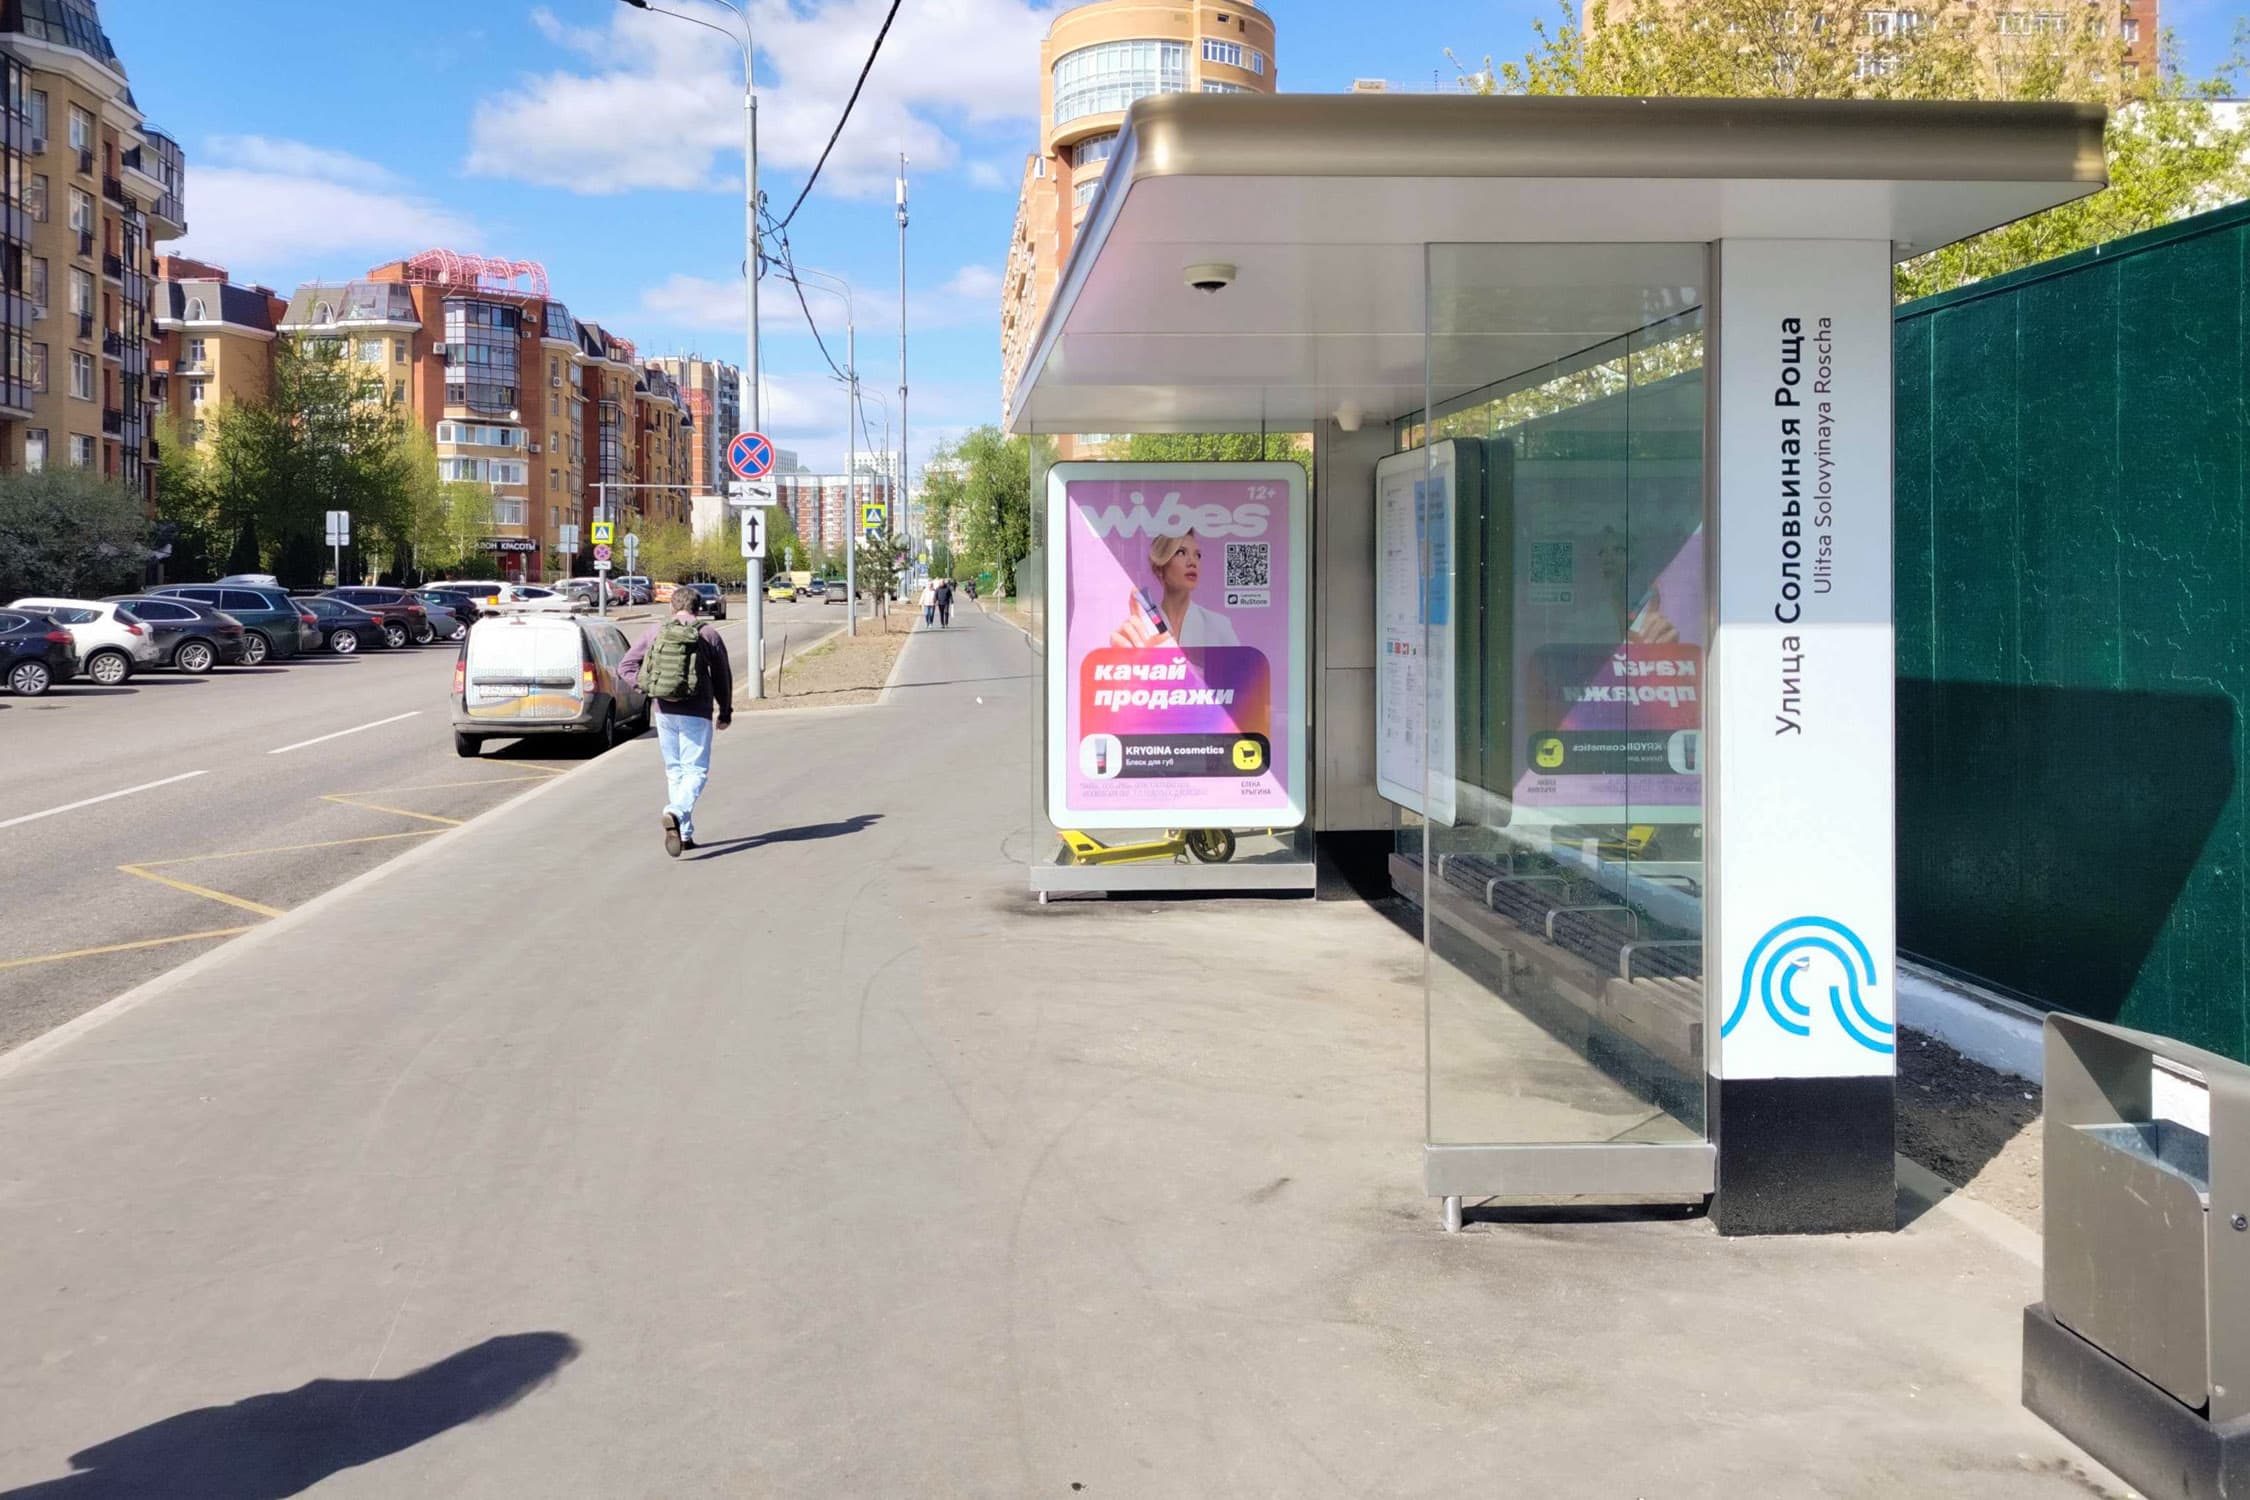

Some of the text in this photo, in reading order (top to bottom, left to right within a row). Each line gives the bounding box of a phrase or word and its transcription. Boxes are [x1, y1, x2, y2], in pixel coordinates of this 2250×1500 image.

[1813, 317, 1836, 595] Ulitsa Solovyinaya Roscha
[1247, 485, 1277, 500] 12+
[1775, 317, 1805, 736] Улица Соловьиная Роща
[1094, 657, 1187, 681] качай
[1094, 688, 1235, 712] продажи
[1125, 745, 1225, 756] KRYGINA cosmetics
